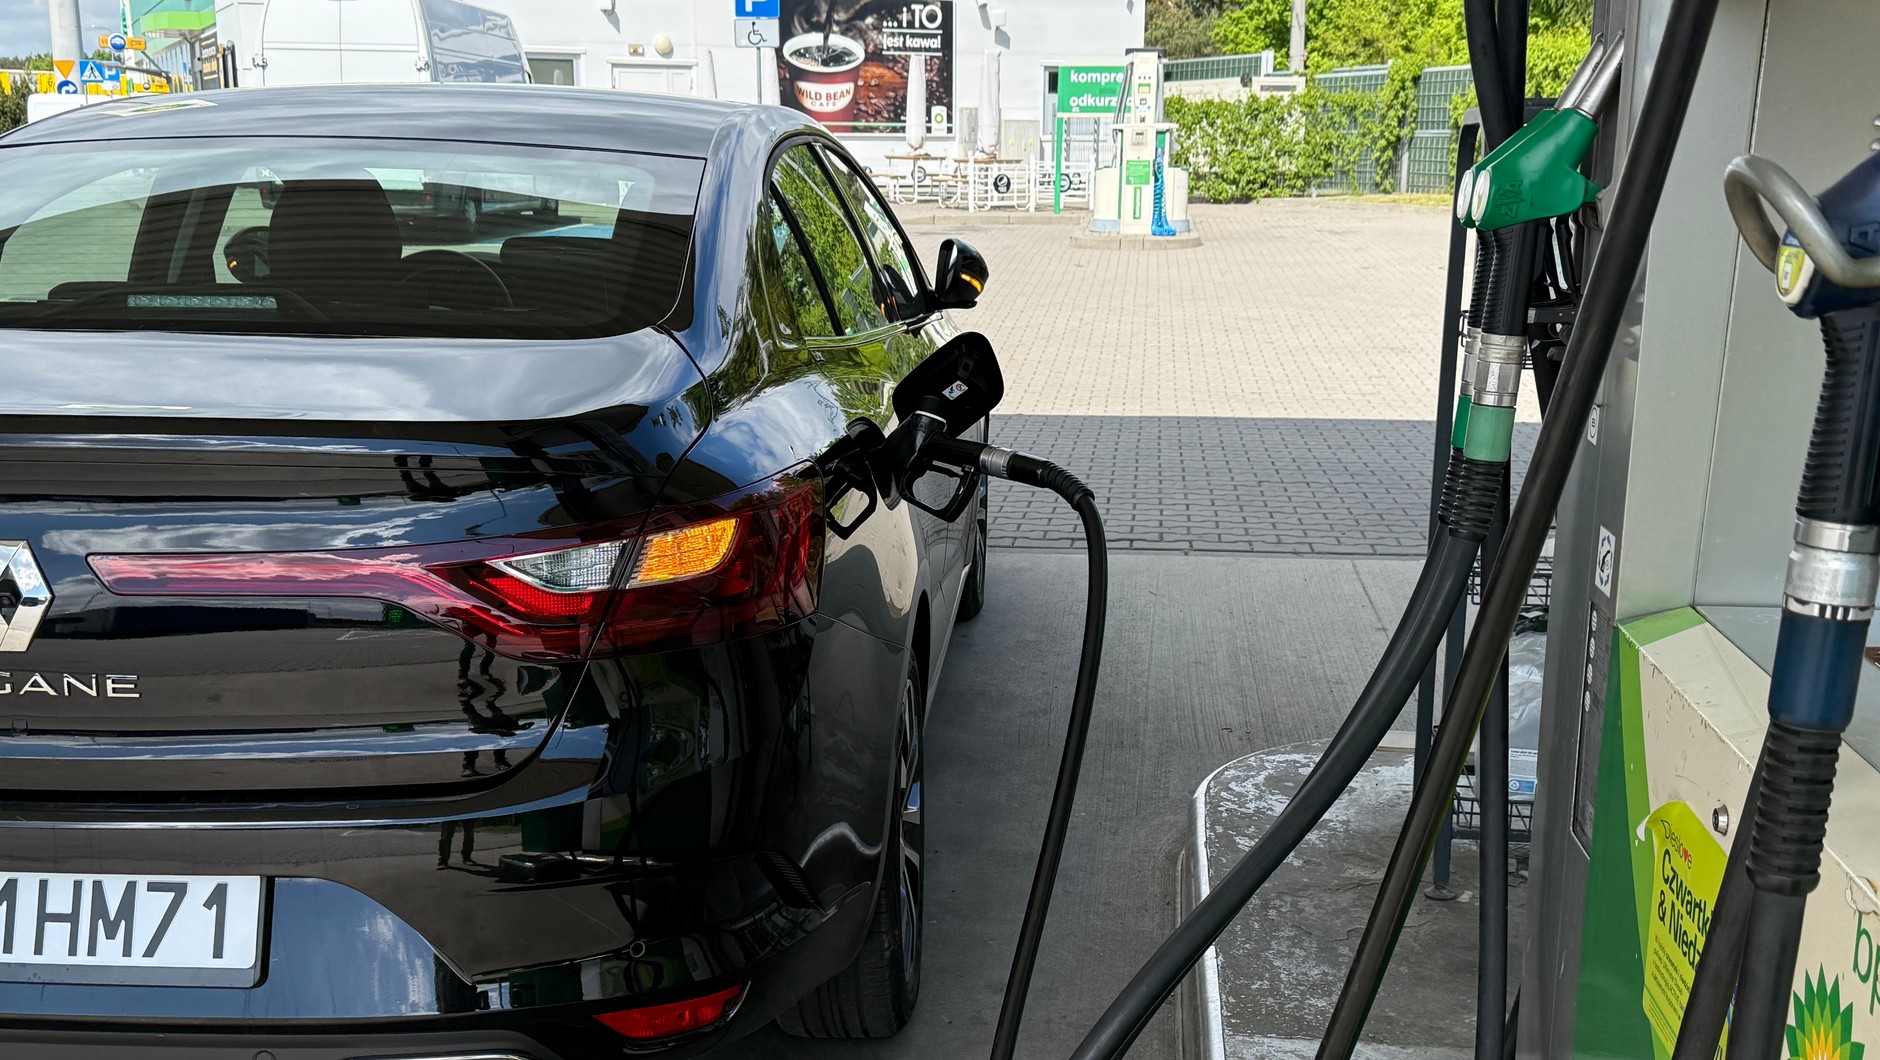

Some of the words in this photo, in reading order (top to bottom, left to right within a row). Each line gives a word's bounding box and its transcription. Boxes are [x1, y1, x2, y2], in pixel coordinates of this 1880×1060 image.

[911, 3, 943, 29] TO
[906, 34, 941, 49] kawa!
[796, 83, 823, 101] WILD
[825, 86, 852, 102] BEAN
[0, 877, 229, 960] 1HM71
[1657, 889, 1667, 927] &
[1668, 899, 1702, 971] Nied
